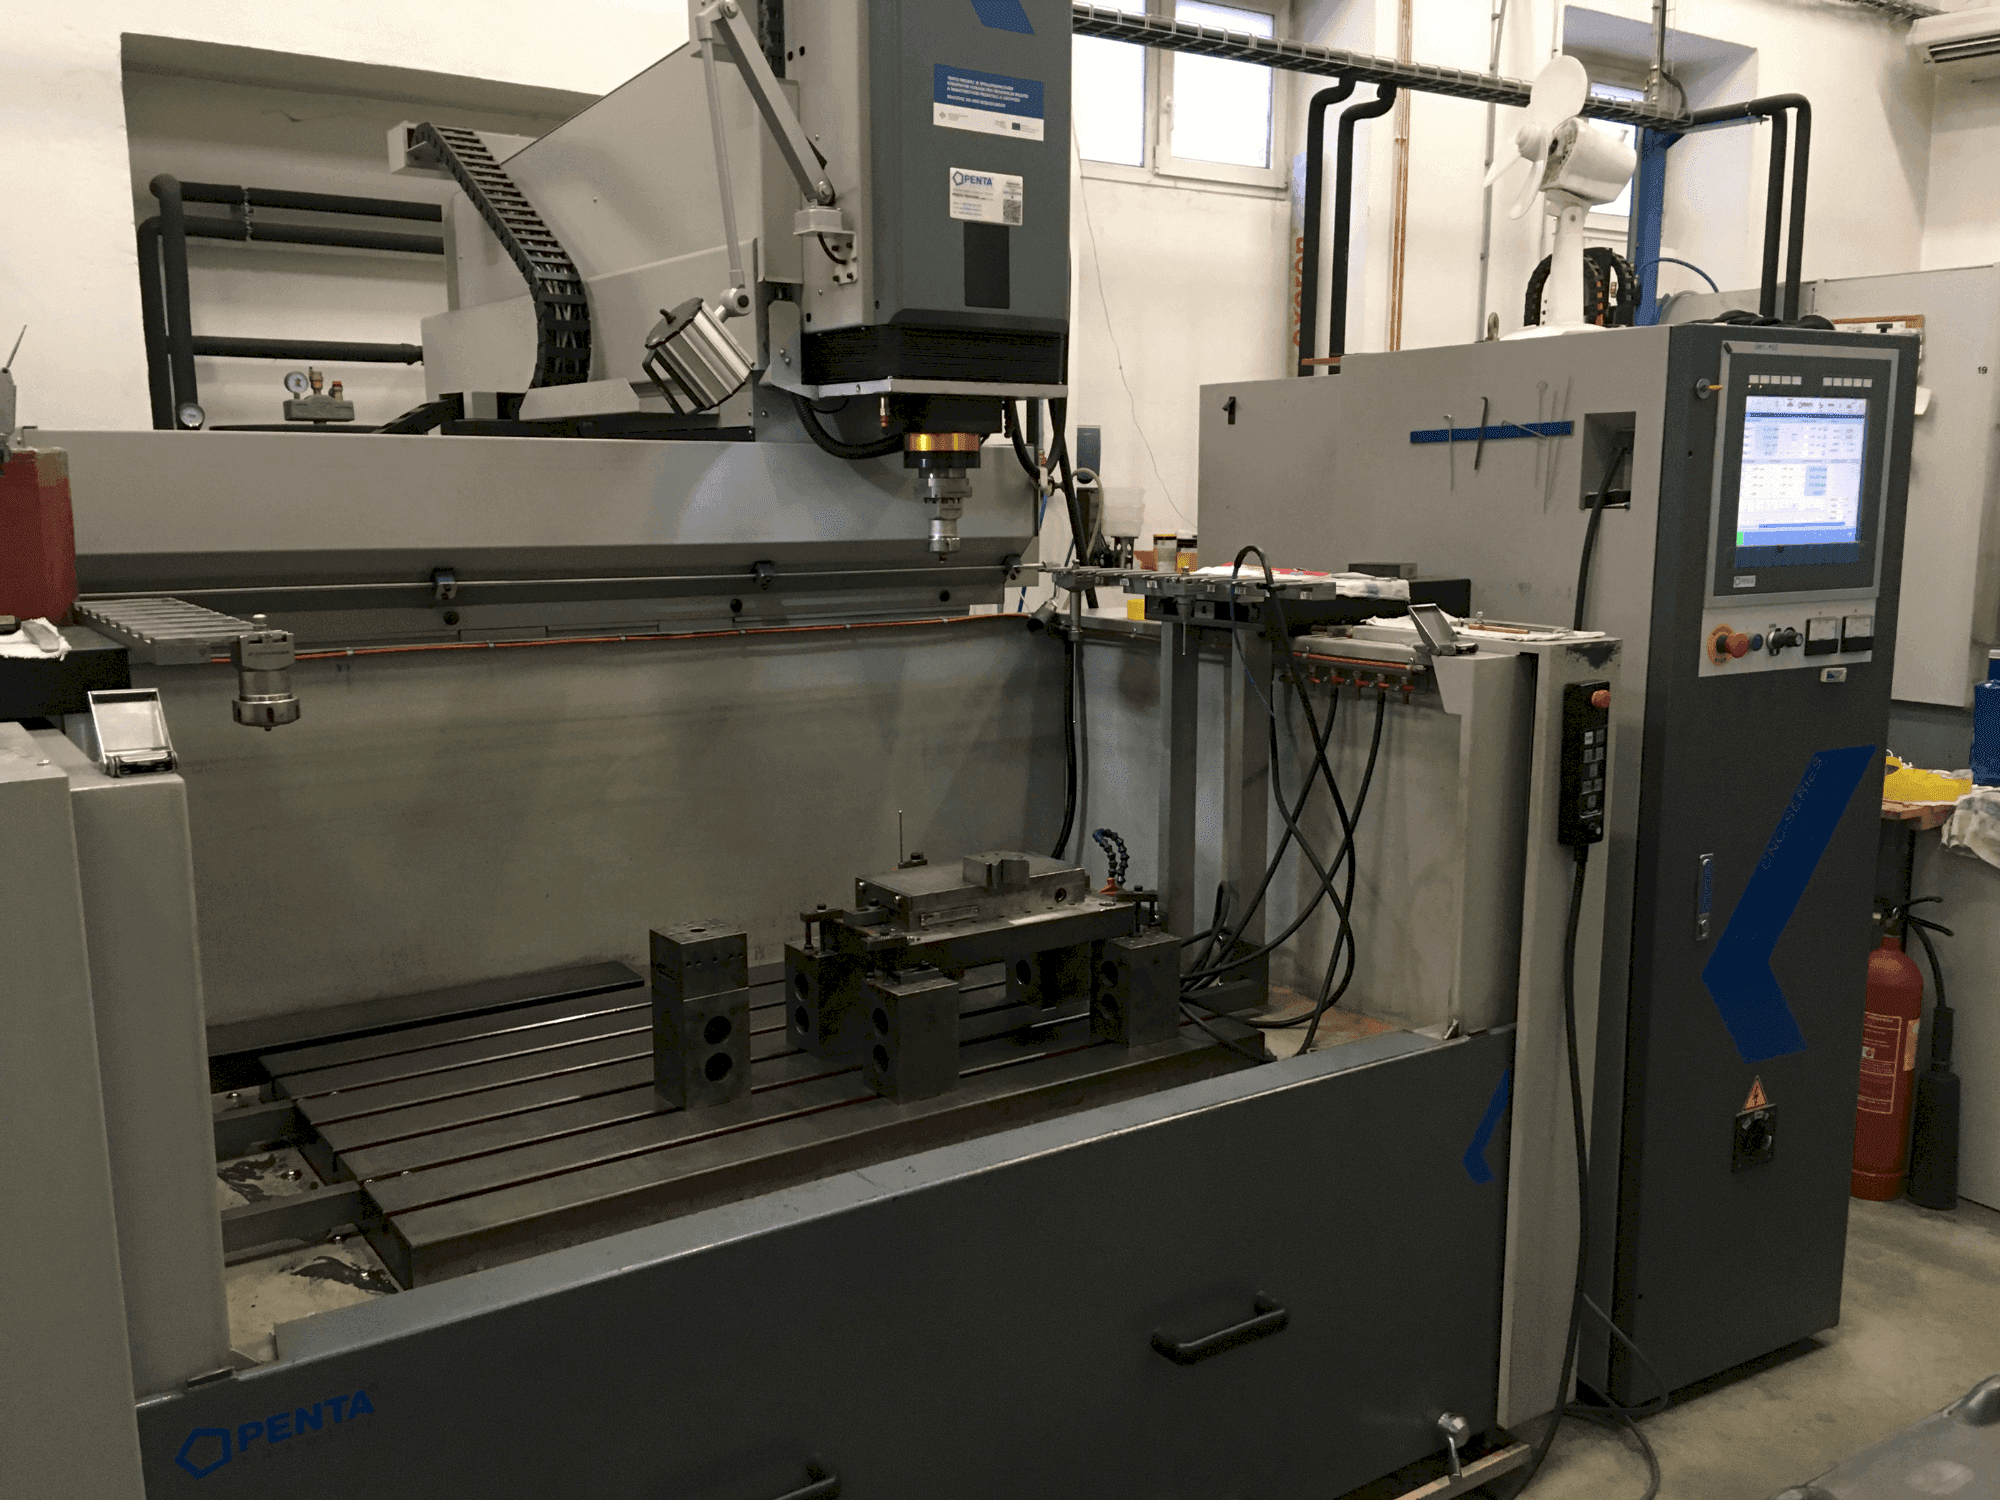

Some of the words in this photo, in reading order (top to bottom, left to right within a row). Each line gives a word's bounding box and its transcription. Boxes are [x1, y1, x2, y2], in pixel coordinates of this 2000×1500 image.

[965, 174, 993, 187] PENTA
[1977, 366, 1988, 375] 19
[237, 1389, 375, 1453] PENTA
